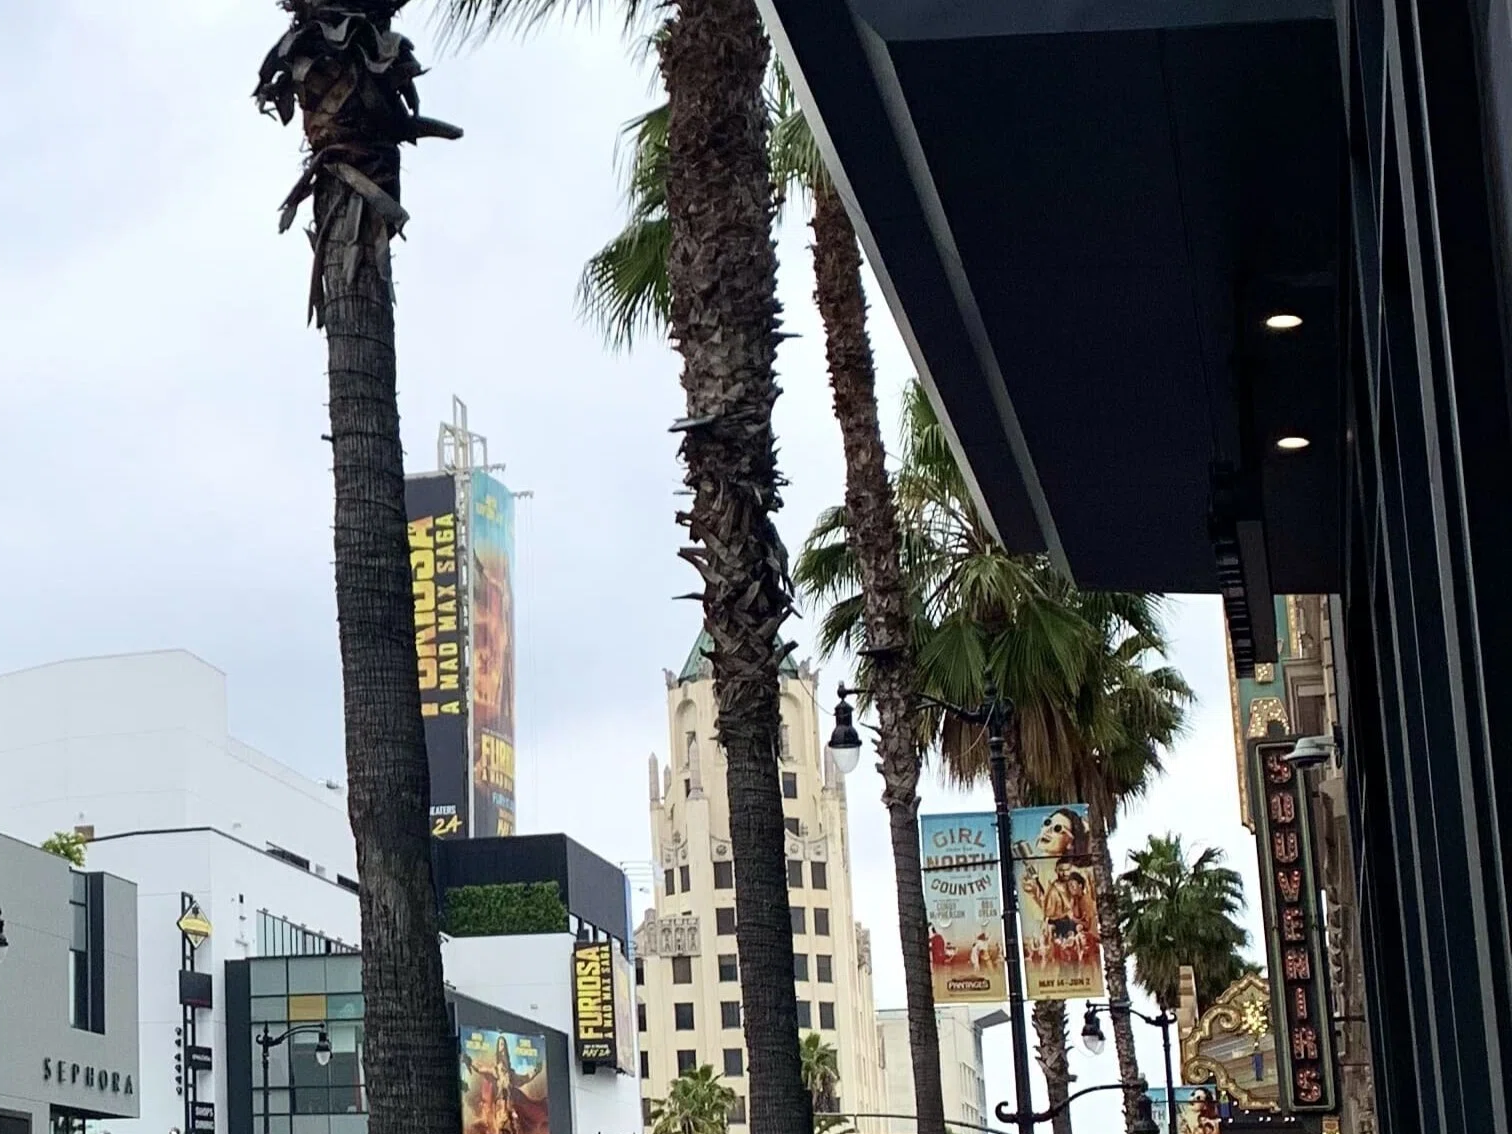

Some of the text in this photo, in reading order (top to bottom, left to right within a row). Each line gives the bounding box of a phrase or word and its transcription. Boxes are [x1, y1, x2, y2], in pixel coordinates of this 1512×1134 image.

[436, 513, 455, 573] SAGA
[438, 584, 457, 631] MAX
[439, 642, 459, 690] MAD
[932, 827, 986, 848] GIRL
[927, 853, 994, 873] NORTH
[931, 875, 992, 895] COUNTRY
[1267, 753, 1321, 1101] SOUVENIRS
[576, 945, 603, 1039] FURIOSA
[43, 1057, 133, 1096] SEPHORA
